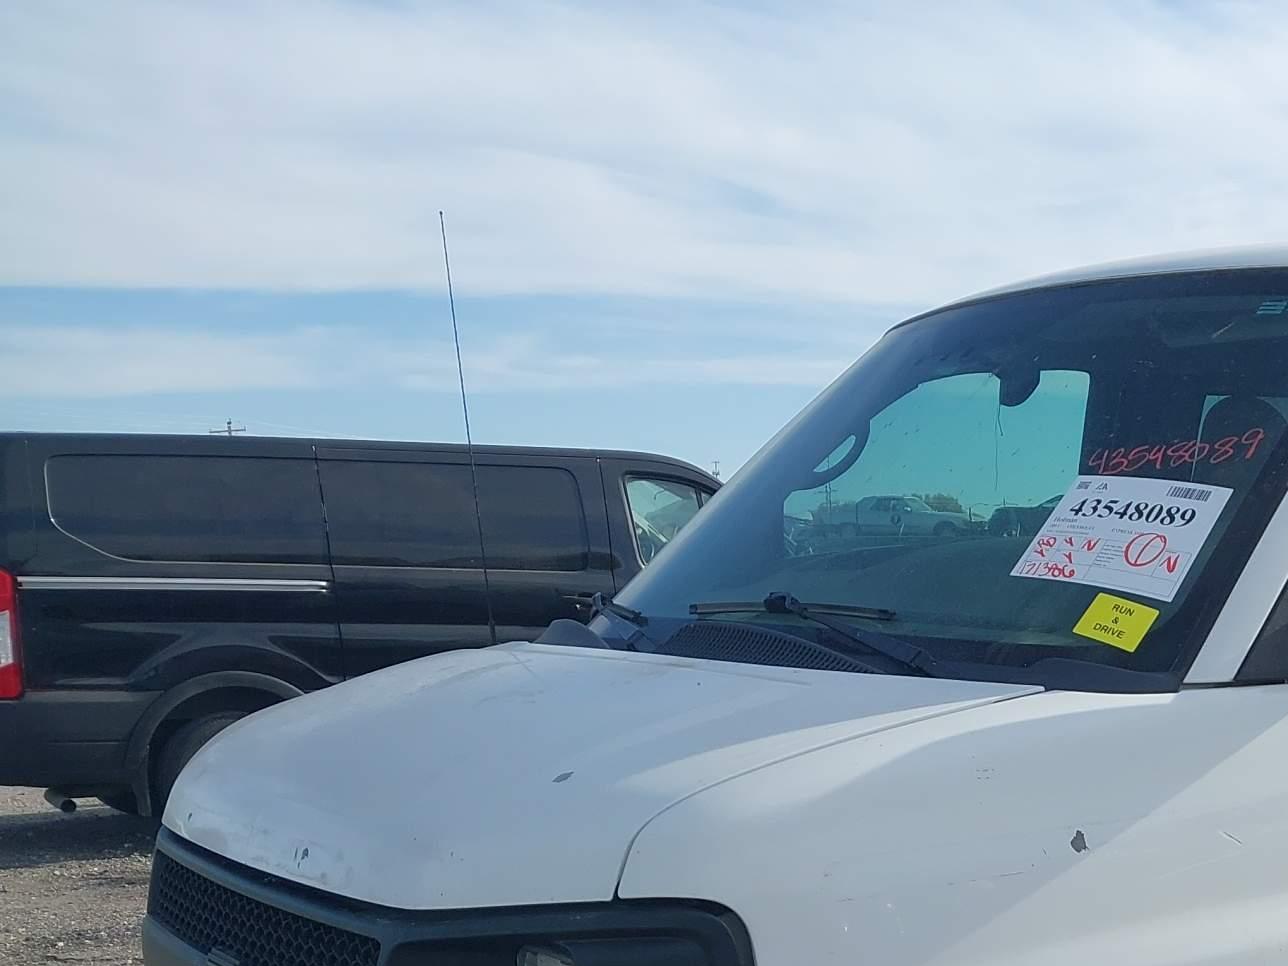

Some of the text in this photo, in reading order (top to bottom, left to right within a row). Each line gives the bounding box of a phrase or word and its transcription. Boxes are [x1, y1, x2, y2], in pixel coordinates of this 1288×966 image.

[1088, 428, 1264, 475] 43548089
[1070, 498, 1197, 528] 43548089
[1081, 537, 1101, 552] N
[1160, 553, 1180, 574] N
[1112, 603, 1135, 617] RUN
[1111, 616, 1120, 625] &
[1093, 622, 1126, 640] DRIVE
